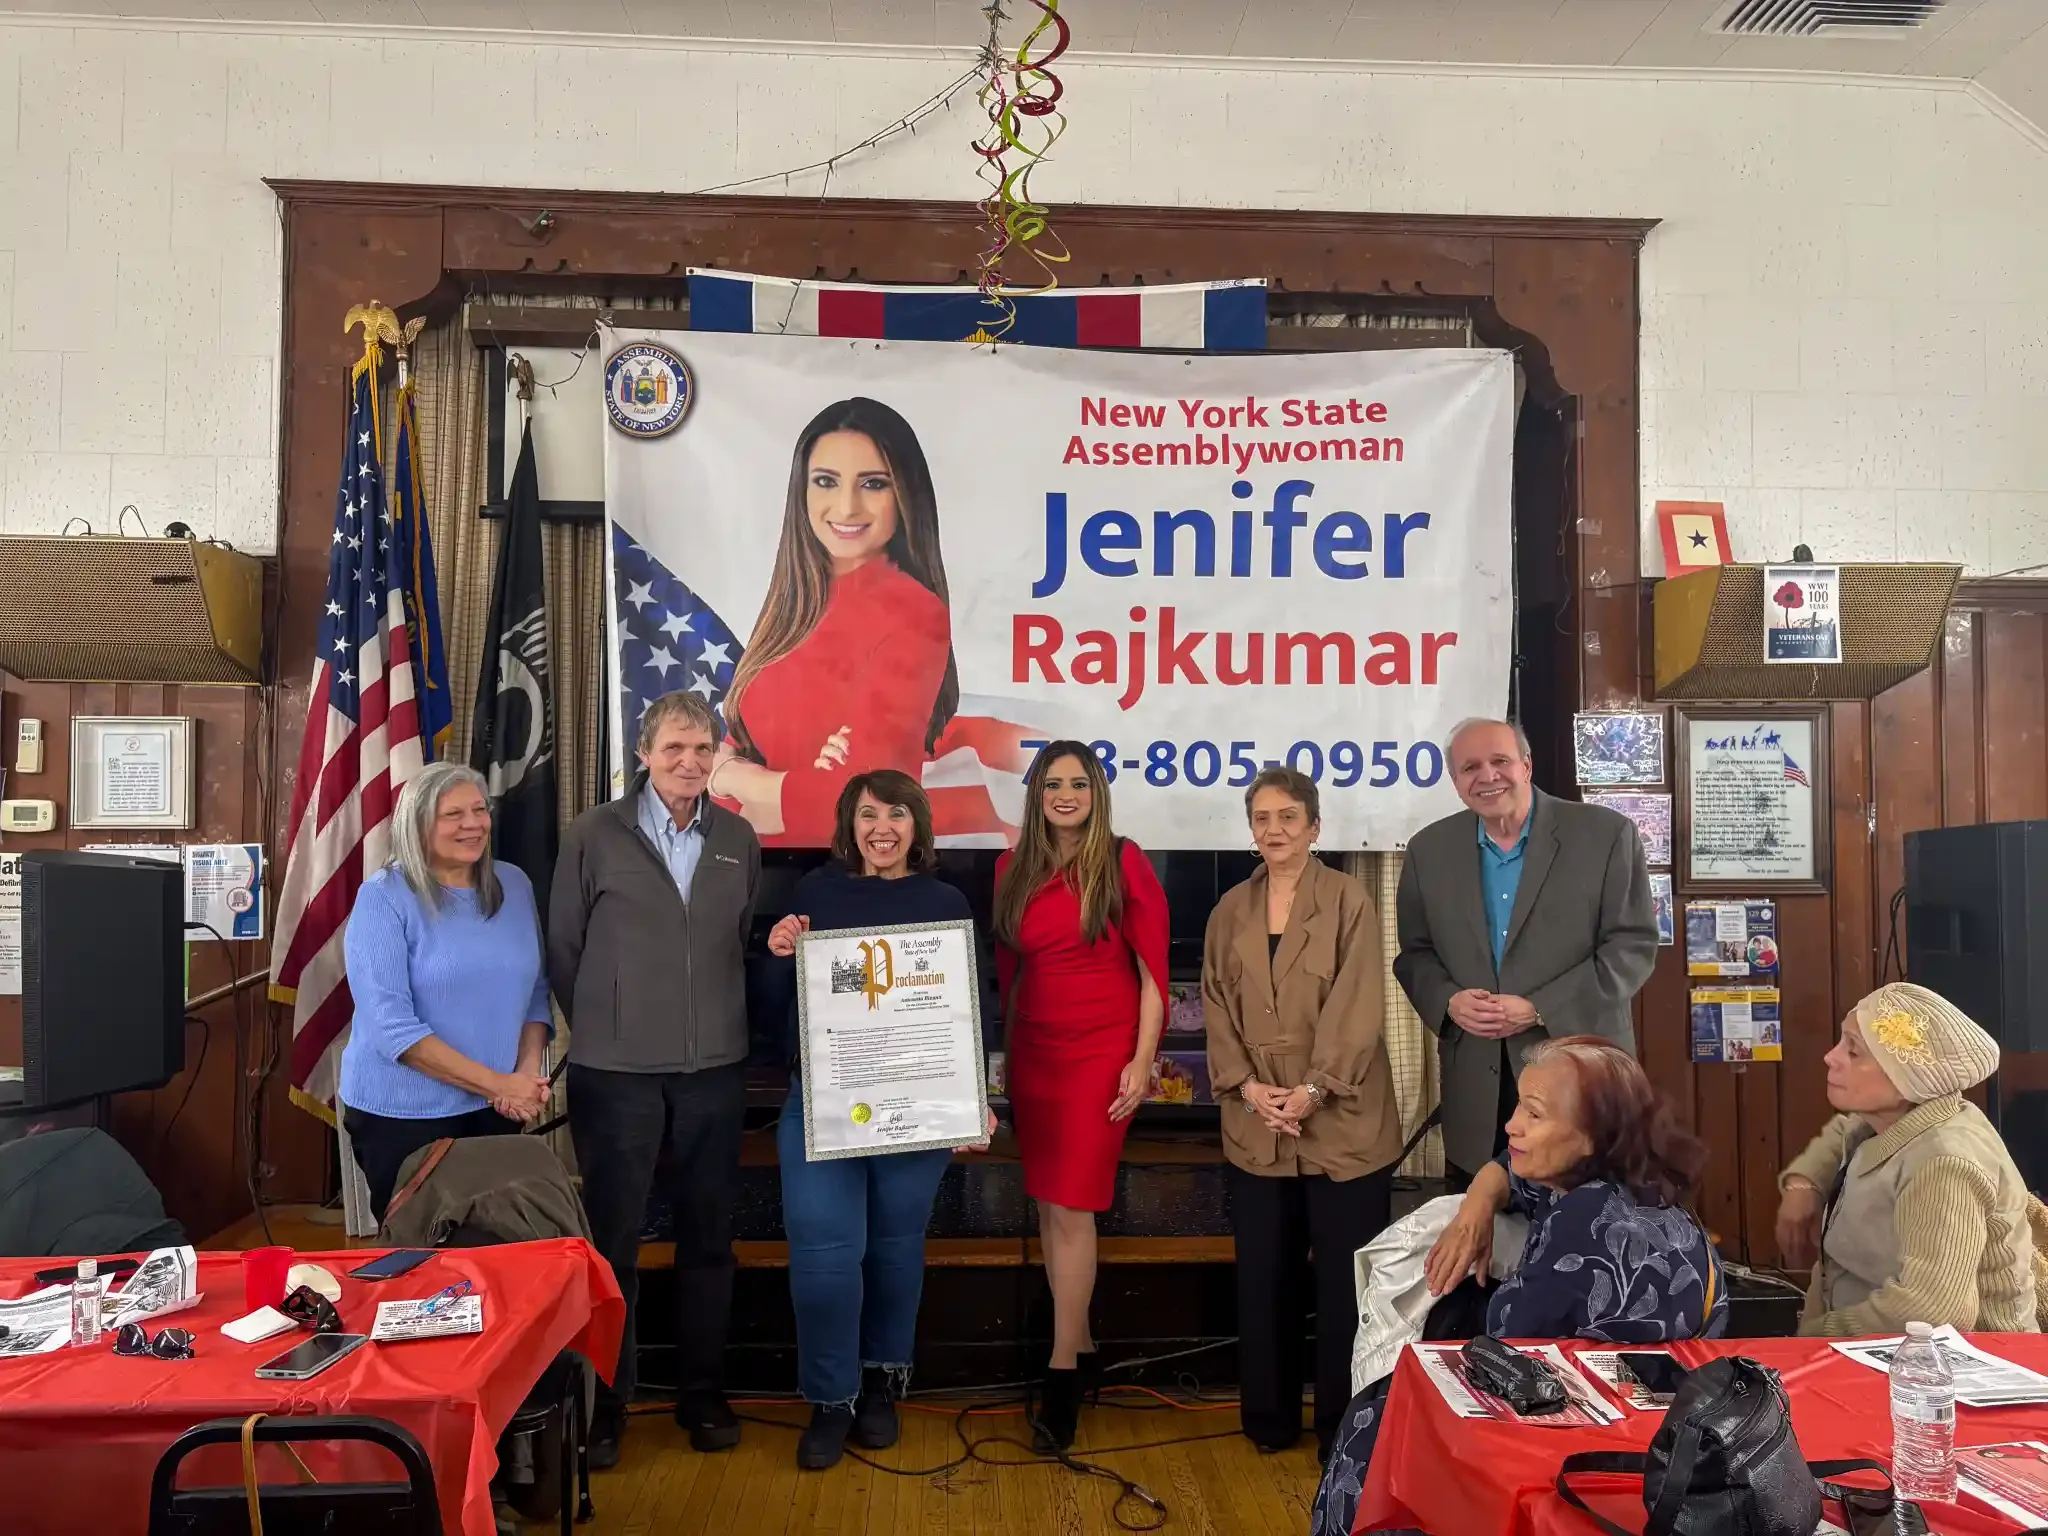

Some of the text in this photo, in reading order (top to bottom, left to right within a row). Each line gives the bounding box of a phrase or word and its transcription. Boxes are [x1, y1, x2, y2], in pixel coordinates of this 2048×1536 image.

[616, 347, 677, 367] ASSEMBLY
[606, 390, 685, 431] STATE OF NEW YORK
[1080, 396, 1388, 429] New York State
[1062, 434, 1404, 475] Assemblywoman
[1031, 479, 1431, 599] Jenifer
[1809, 590, 1828, 603] 100
[1011, 606, 1458, 711] Rajkumar
[1020, 739, 1443, 788] 78-805-0950
[899, 937, 942, 949] The Assembly
